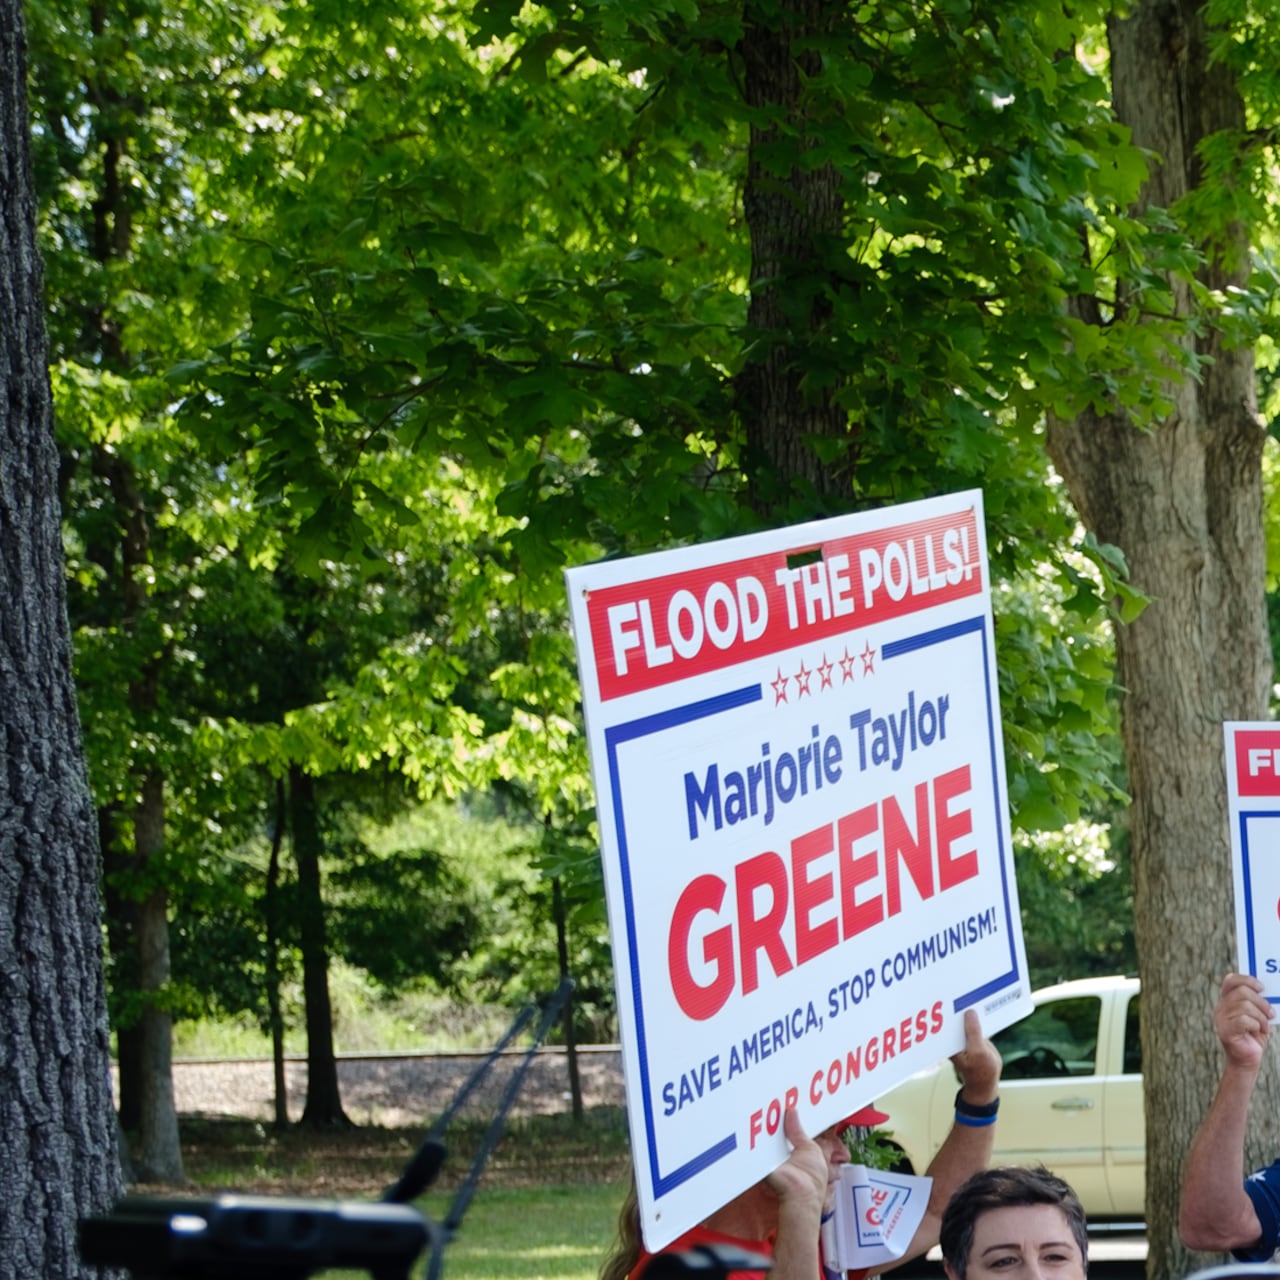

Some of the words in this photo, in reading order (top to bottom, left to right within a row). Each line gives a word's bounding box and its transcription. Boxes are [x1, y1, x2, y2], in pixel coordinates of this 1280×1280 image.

[607, 574, 769, 676] FLOOD
[775, 553, 855, 630] THE
[861, 526, 973, 609] POLLS!
[684, 725, 842, 841] Marjorie
[850, 692, 949, 771] Taylor
[668, 765, 979, 1021] GREENE
[662, 1055, 722, 1117] SAVE
[728, 1001, 824, 1081] AMERICA,
[828, 968, 876, 1019] STOP
[881, 906, 997, 988] COMMUNISM!
[750, 1087, 799, 1150] FOR
[810, 1001, 944, 1106] CONGRESS
